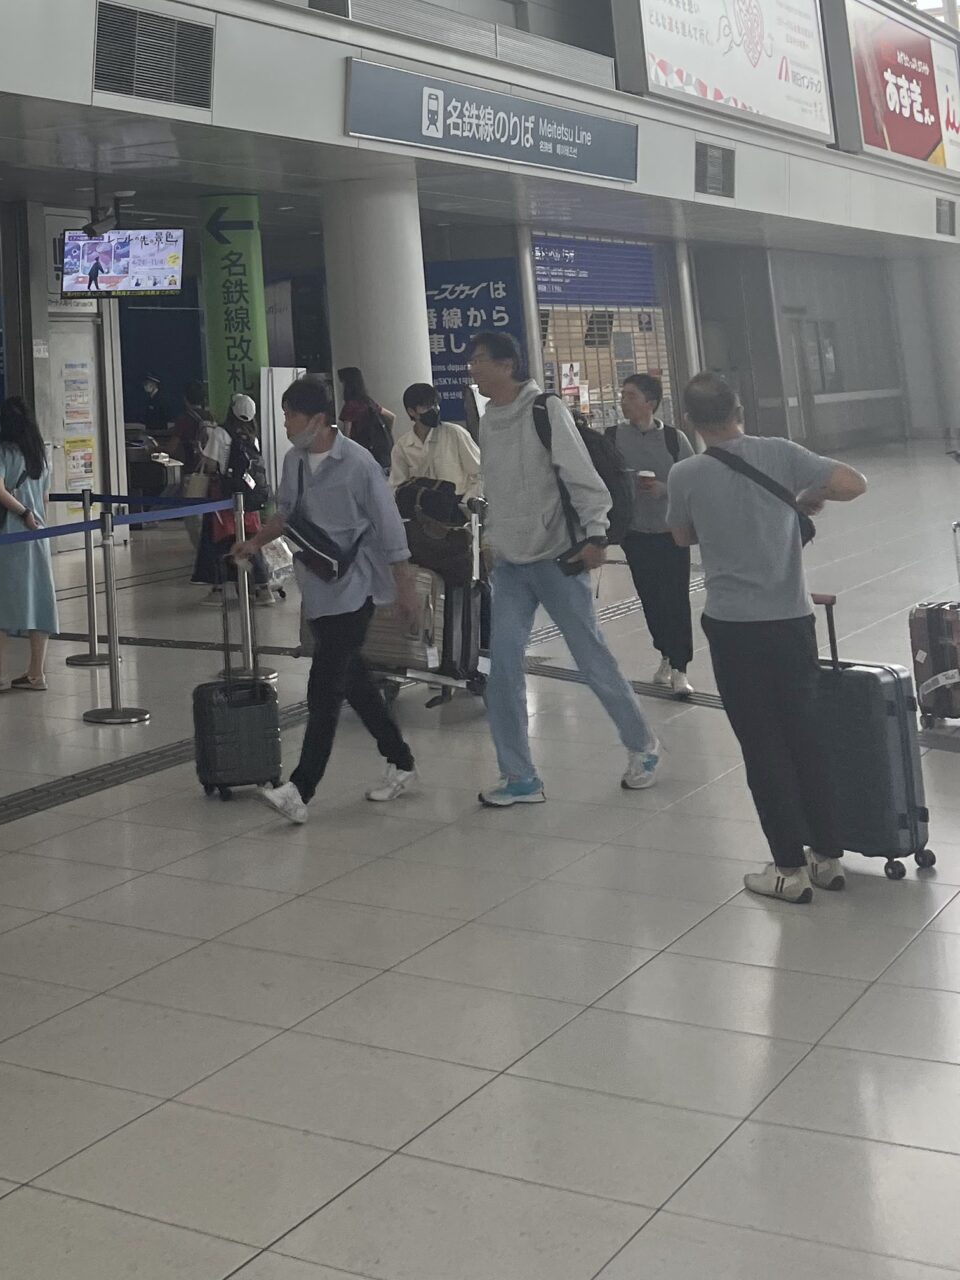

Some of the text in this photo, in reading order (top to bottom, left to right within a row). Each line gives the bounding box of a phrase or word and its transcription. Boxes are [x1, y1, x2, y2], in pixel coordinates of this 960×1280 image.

[446, 97, 536, 148] 名鉄線のりば
[539, 118, 592, 145] Meitetsu Line
[429, 333, 476, 355] 車し
